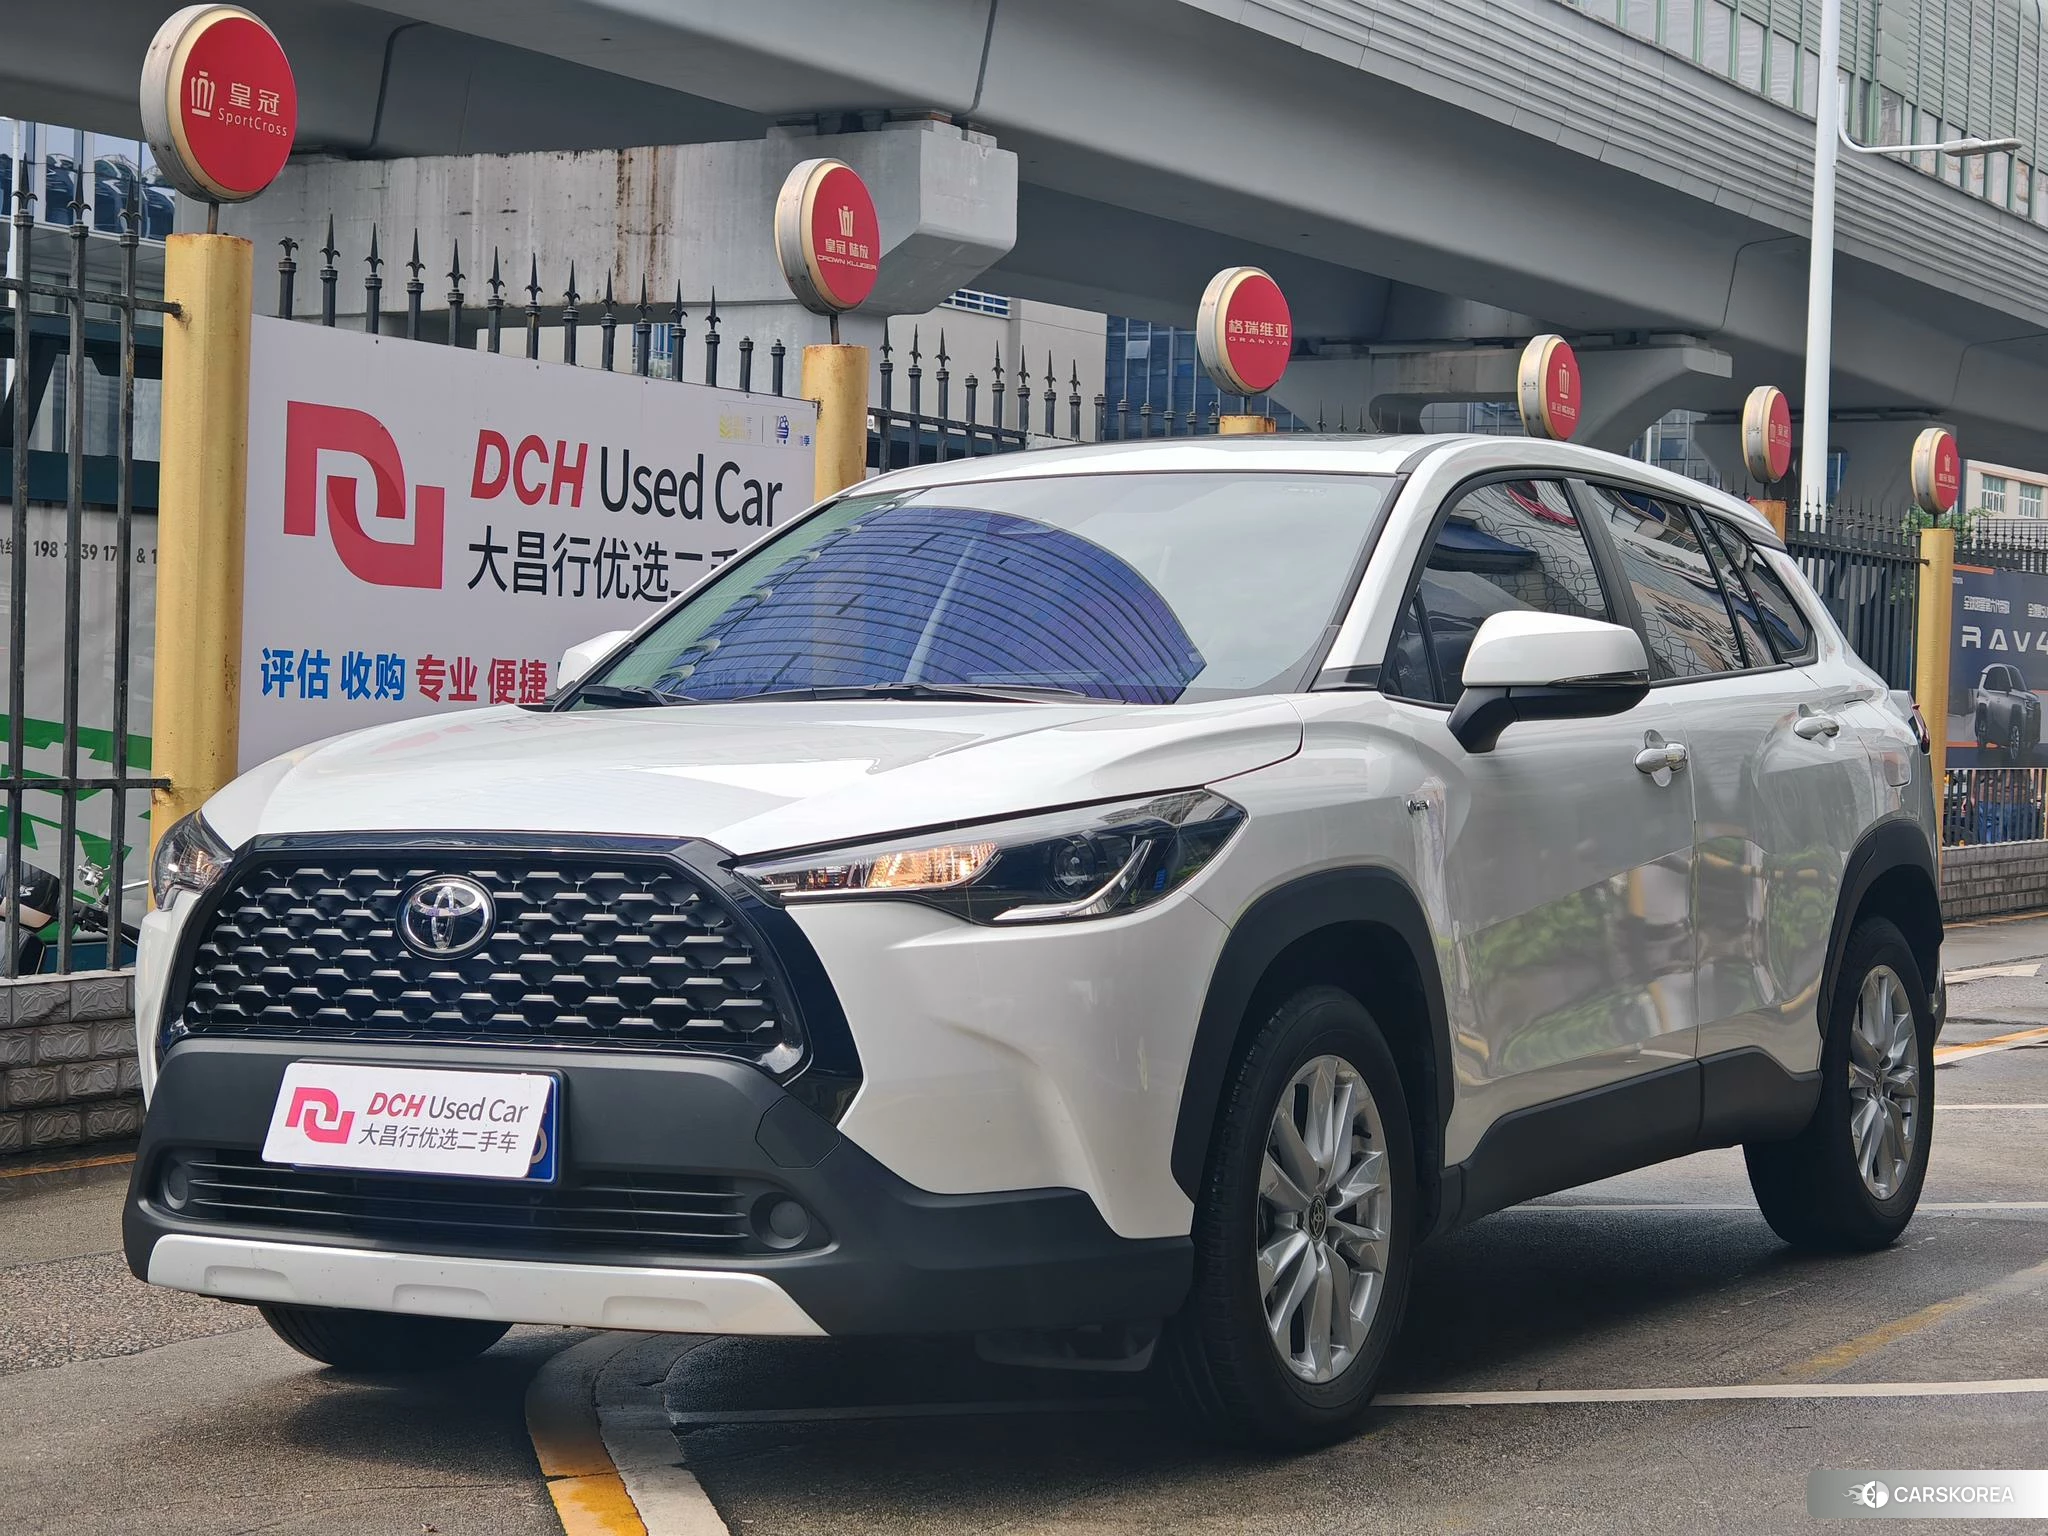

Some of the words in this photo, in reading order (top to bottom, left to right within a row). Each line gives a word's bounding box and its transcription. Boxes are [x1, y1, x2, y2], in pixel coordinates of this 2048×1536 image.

[228, 82, 280, 116] 皇冠
[218, 107, 287, 137] SportCross
[1228, 319, 1289, 338] 格瑞维亚
[1228, 336, 1289, 346] GRANVIA
[470, 428, 589, 508] DCH
[600, 446, 704, 520] Used
[715, 461, 783, 527] Car
[33, 540, 58, 558] 198
[261, 648, 331, 699] 评估
[340, 651, 406, 701] 收购
[415, 654, 478, 702] 专业
[487, 658, 548, 704] 便捷
[366, 1092, 426, 1118] DCH
[428, 1096, 487, 1121] Used
[488, 1099, 529, 1123] Car
[358, 1123, 520, 1155] 大昌行优选二手车
